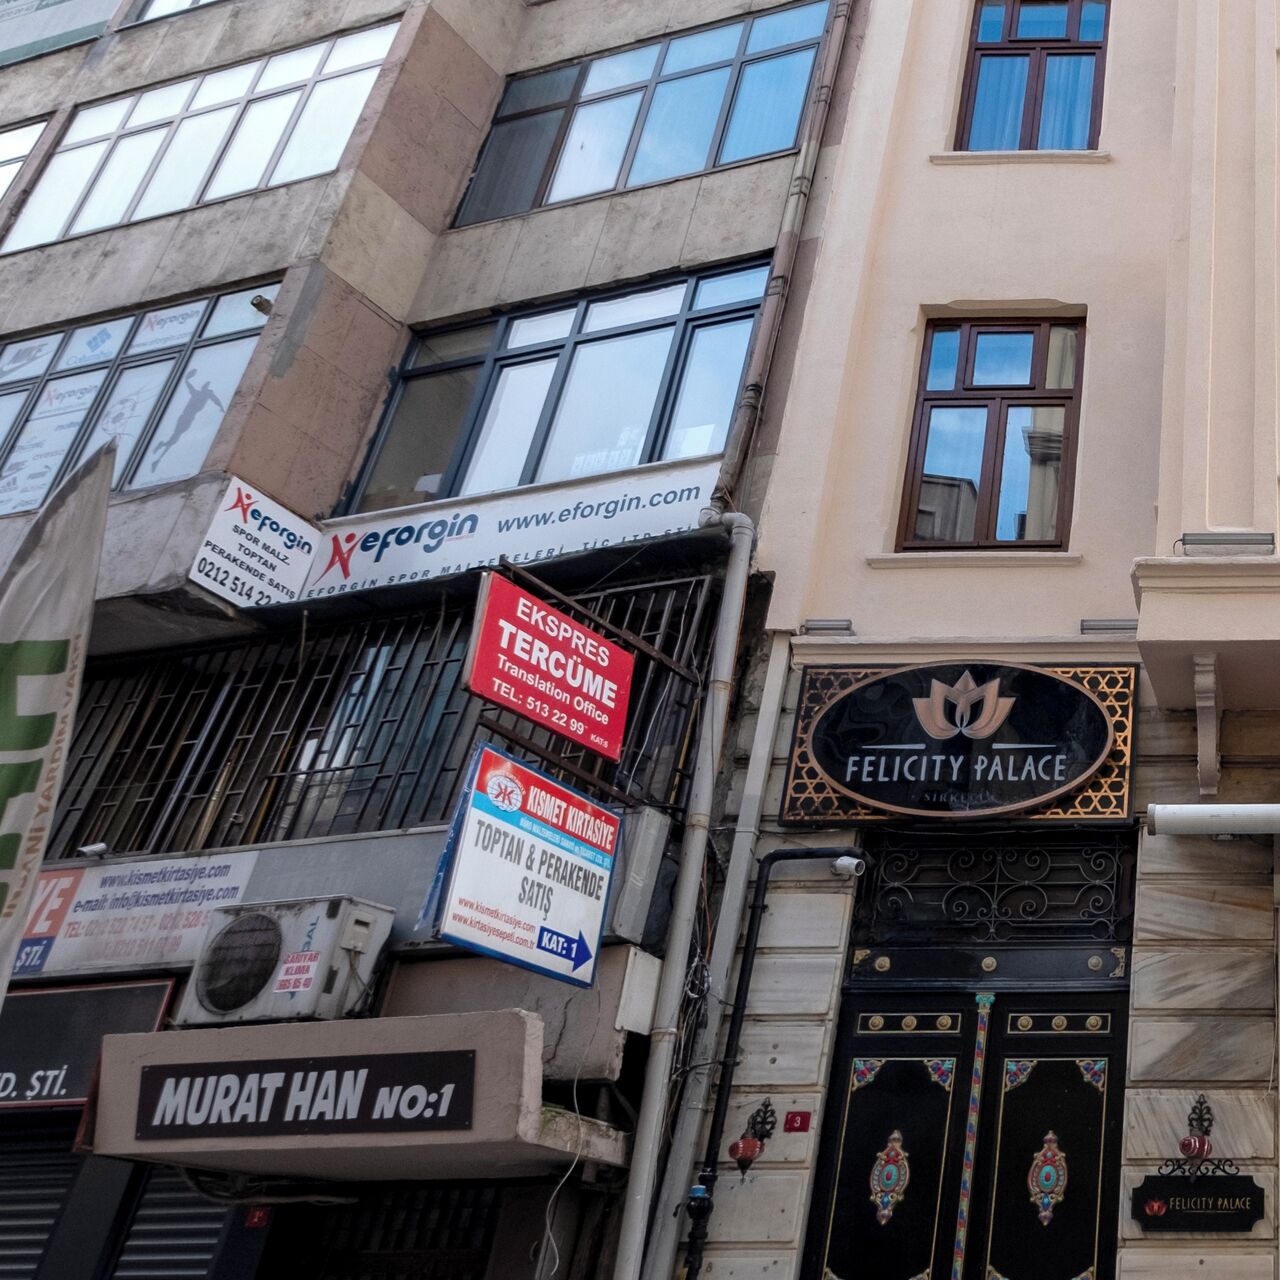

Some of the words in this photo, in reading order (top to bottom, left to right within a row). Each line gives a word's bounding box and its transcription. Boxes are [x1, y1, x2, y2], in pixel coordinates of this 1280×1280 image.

[232, 524, 260, 546] SPOR
[250, 508, 313, 555] eforgin
[360, 513, 479, 563] eforgin
[498, 486, 700, 533] www.eforgin.com
[197, 557, 230, 587] 0212
[230, 576, 254, 601] 514
[204, 540, 266, 582] PERAKENDE
[268, 578, 297, 600] SATIŞ
[238, 543, 277, 572] TOPTAN
[307, 576, 378, 598] EFORGİN
[387, 569, 430, 584] SPOR
[516, 597, 610, 667] EKSPRES
[498, 618, 617, 709] TERCÜME
[492, 677, 523, 705] TEL:
[526, 696, 550, 718] 513
[552, 709, 567, 727] 22
[570, 718, 585, 735] 99
[497, 654, 571, 705] Translation
[573, 696, 609, 725] Office
[846, 755, 964, 782] FELICITY
[974, 755, 1067, 781] PALACE
[526, 786, 567, 827] KISMET
[566, 803, 615, 851] KIRTASİYE
[474, 819, 525, 866] TOPTAN
[525, 843, 536, 871] &
[538, 849, 604, 901] PERAKENDE
[518, 876, 554, 921] SATIŞ
[541, 931, 567, 955] KAT:
[570, 941, 577, 958] 1
[25, 1064, 69, 1101] ŞTİ.
[152, 1071, 284, 1126] MURAT
[284, 1068, 369, 1121] HAN
[372, 1083, 455, 1120] NO:1
[794, 1116, 801, 1127] 3
[1169, 1197, 1213, 1210] FELICITY
[1217, 1197, 1252, 1210] PALACE
